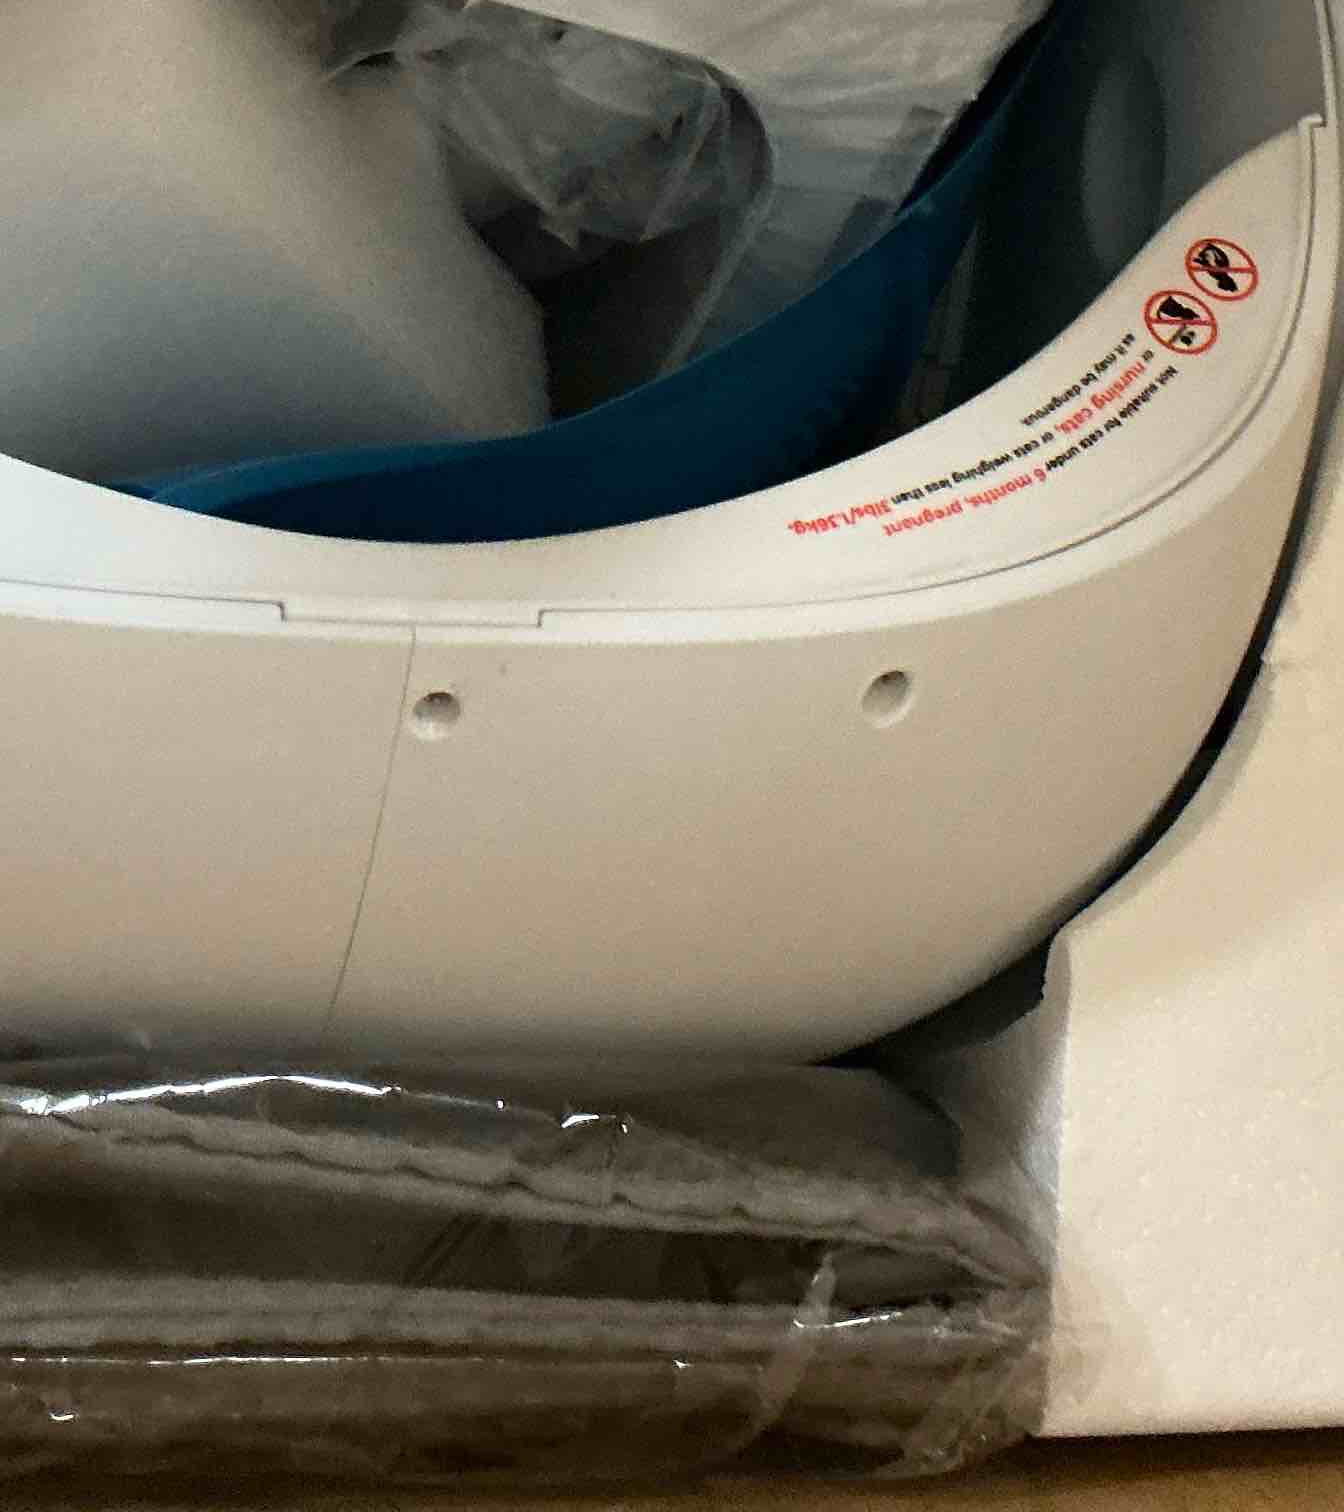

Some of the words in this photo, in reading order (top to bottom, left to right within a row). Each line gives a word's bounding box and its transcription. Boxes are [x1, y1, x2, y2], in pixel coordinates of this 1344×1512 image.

[1121, 333, 1135, 346] as
[1094, 353, 1117, 374] may
[1141, 349, 1154, 361] or
[1079, 372, 1098, 386] be
[1090, 361, 1146, 410] nursing
[1054, 407, 1094, 434] cats,
[1103, 417, 1123, 432] for
[1041, 431, 1054, 444] or
[1078, 429, 1104, 449] cats
[1012, 440, 1041, 458] cats
[1045, 446, 1081, 471] under
[951, 453, 1013, 484] weighing
[1033, 468, 1047, 482] 6
[924, 479, 953, 493] less
[964, 474, 1033, 507] months,
[890, 487, 925, 505] than
[882, 499, 964, 537] pregnant
